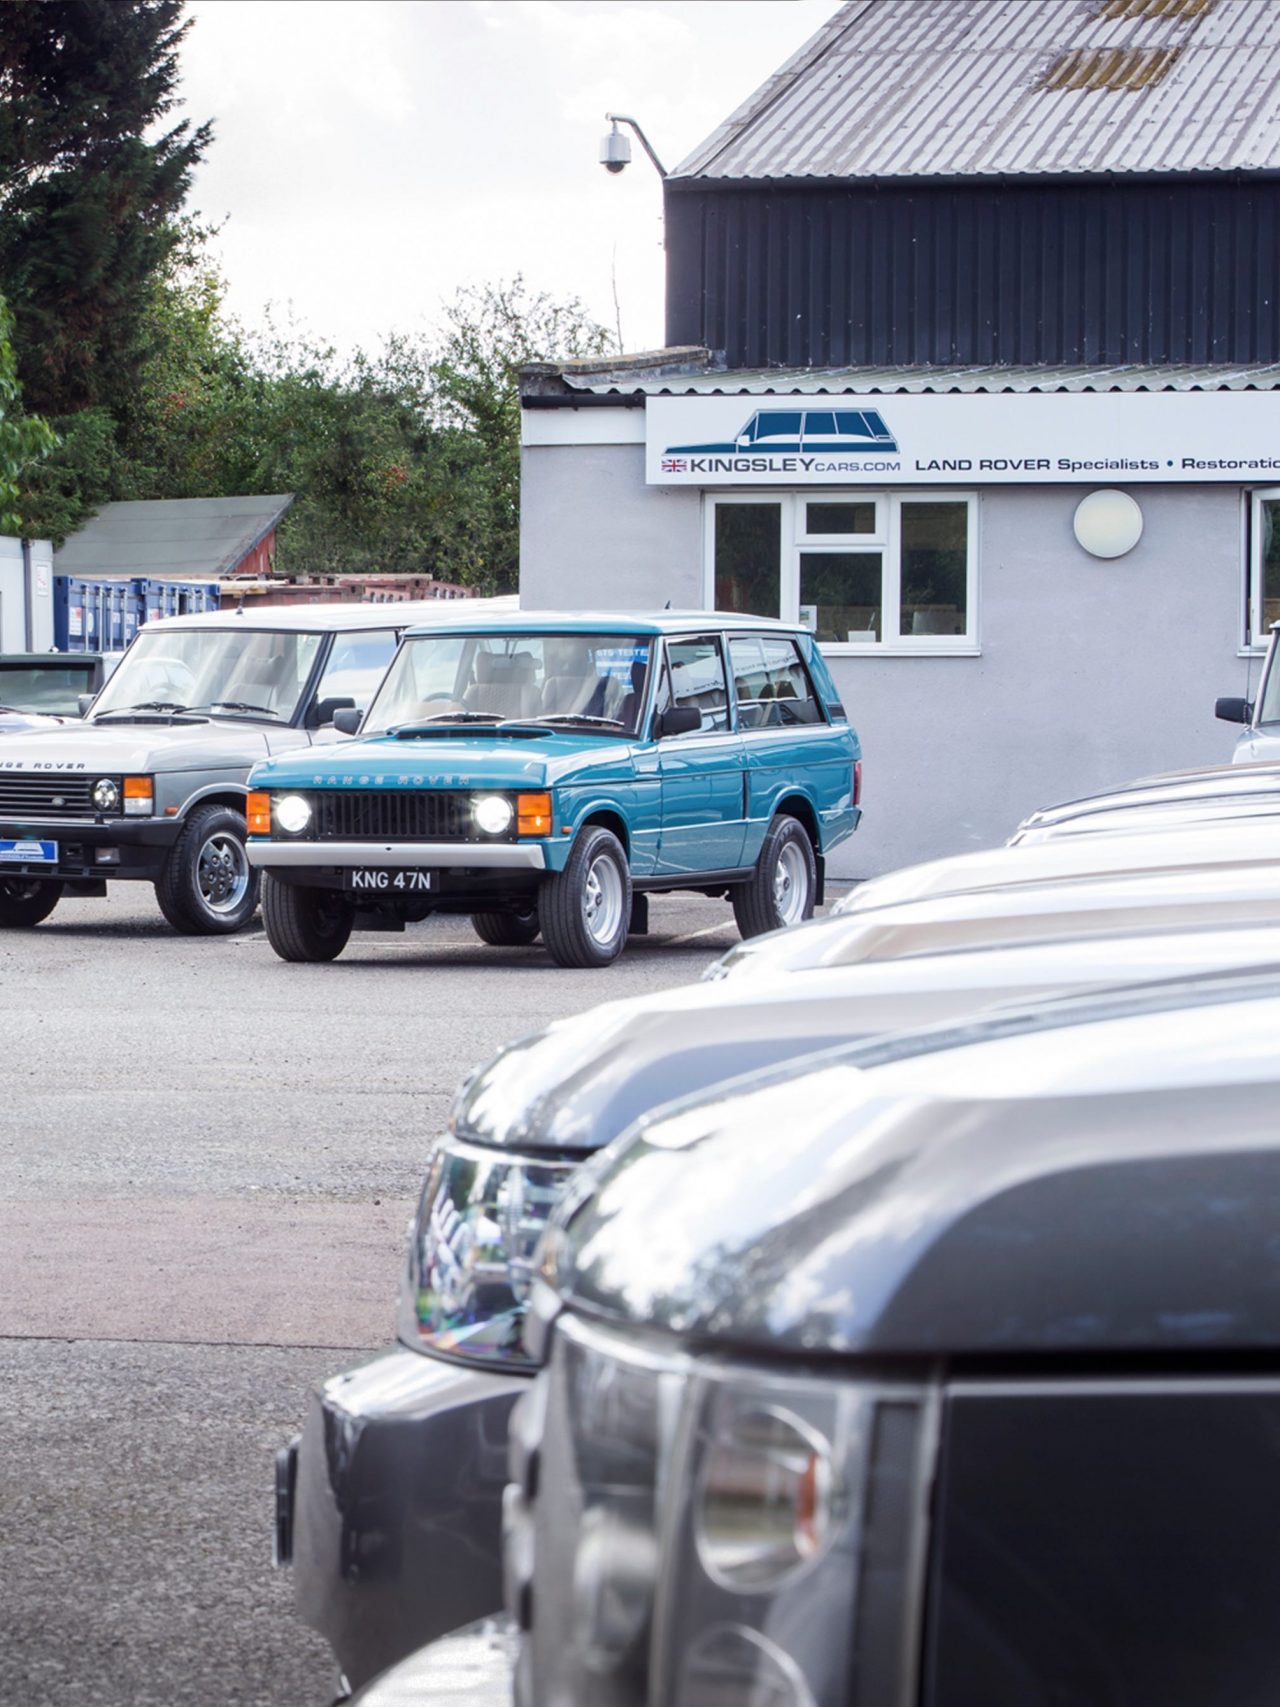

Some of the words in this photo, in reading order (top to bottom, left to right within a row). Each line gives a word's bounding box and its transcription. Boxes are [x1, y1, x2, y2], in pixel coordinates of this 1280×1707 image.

[915, 459, 972, 471] LAND
[979, 458, 1051, 471] ROVER
[1057, 458, 1160, 473] Specialists
[33, 762, 86, 770] ROVER
[312, 775, 385, 785] RANGE
[397, 775, 470, 785] ROVER
[351, 870, 389, 889] KNG
[393, 871, 431, 890] 47N
